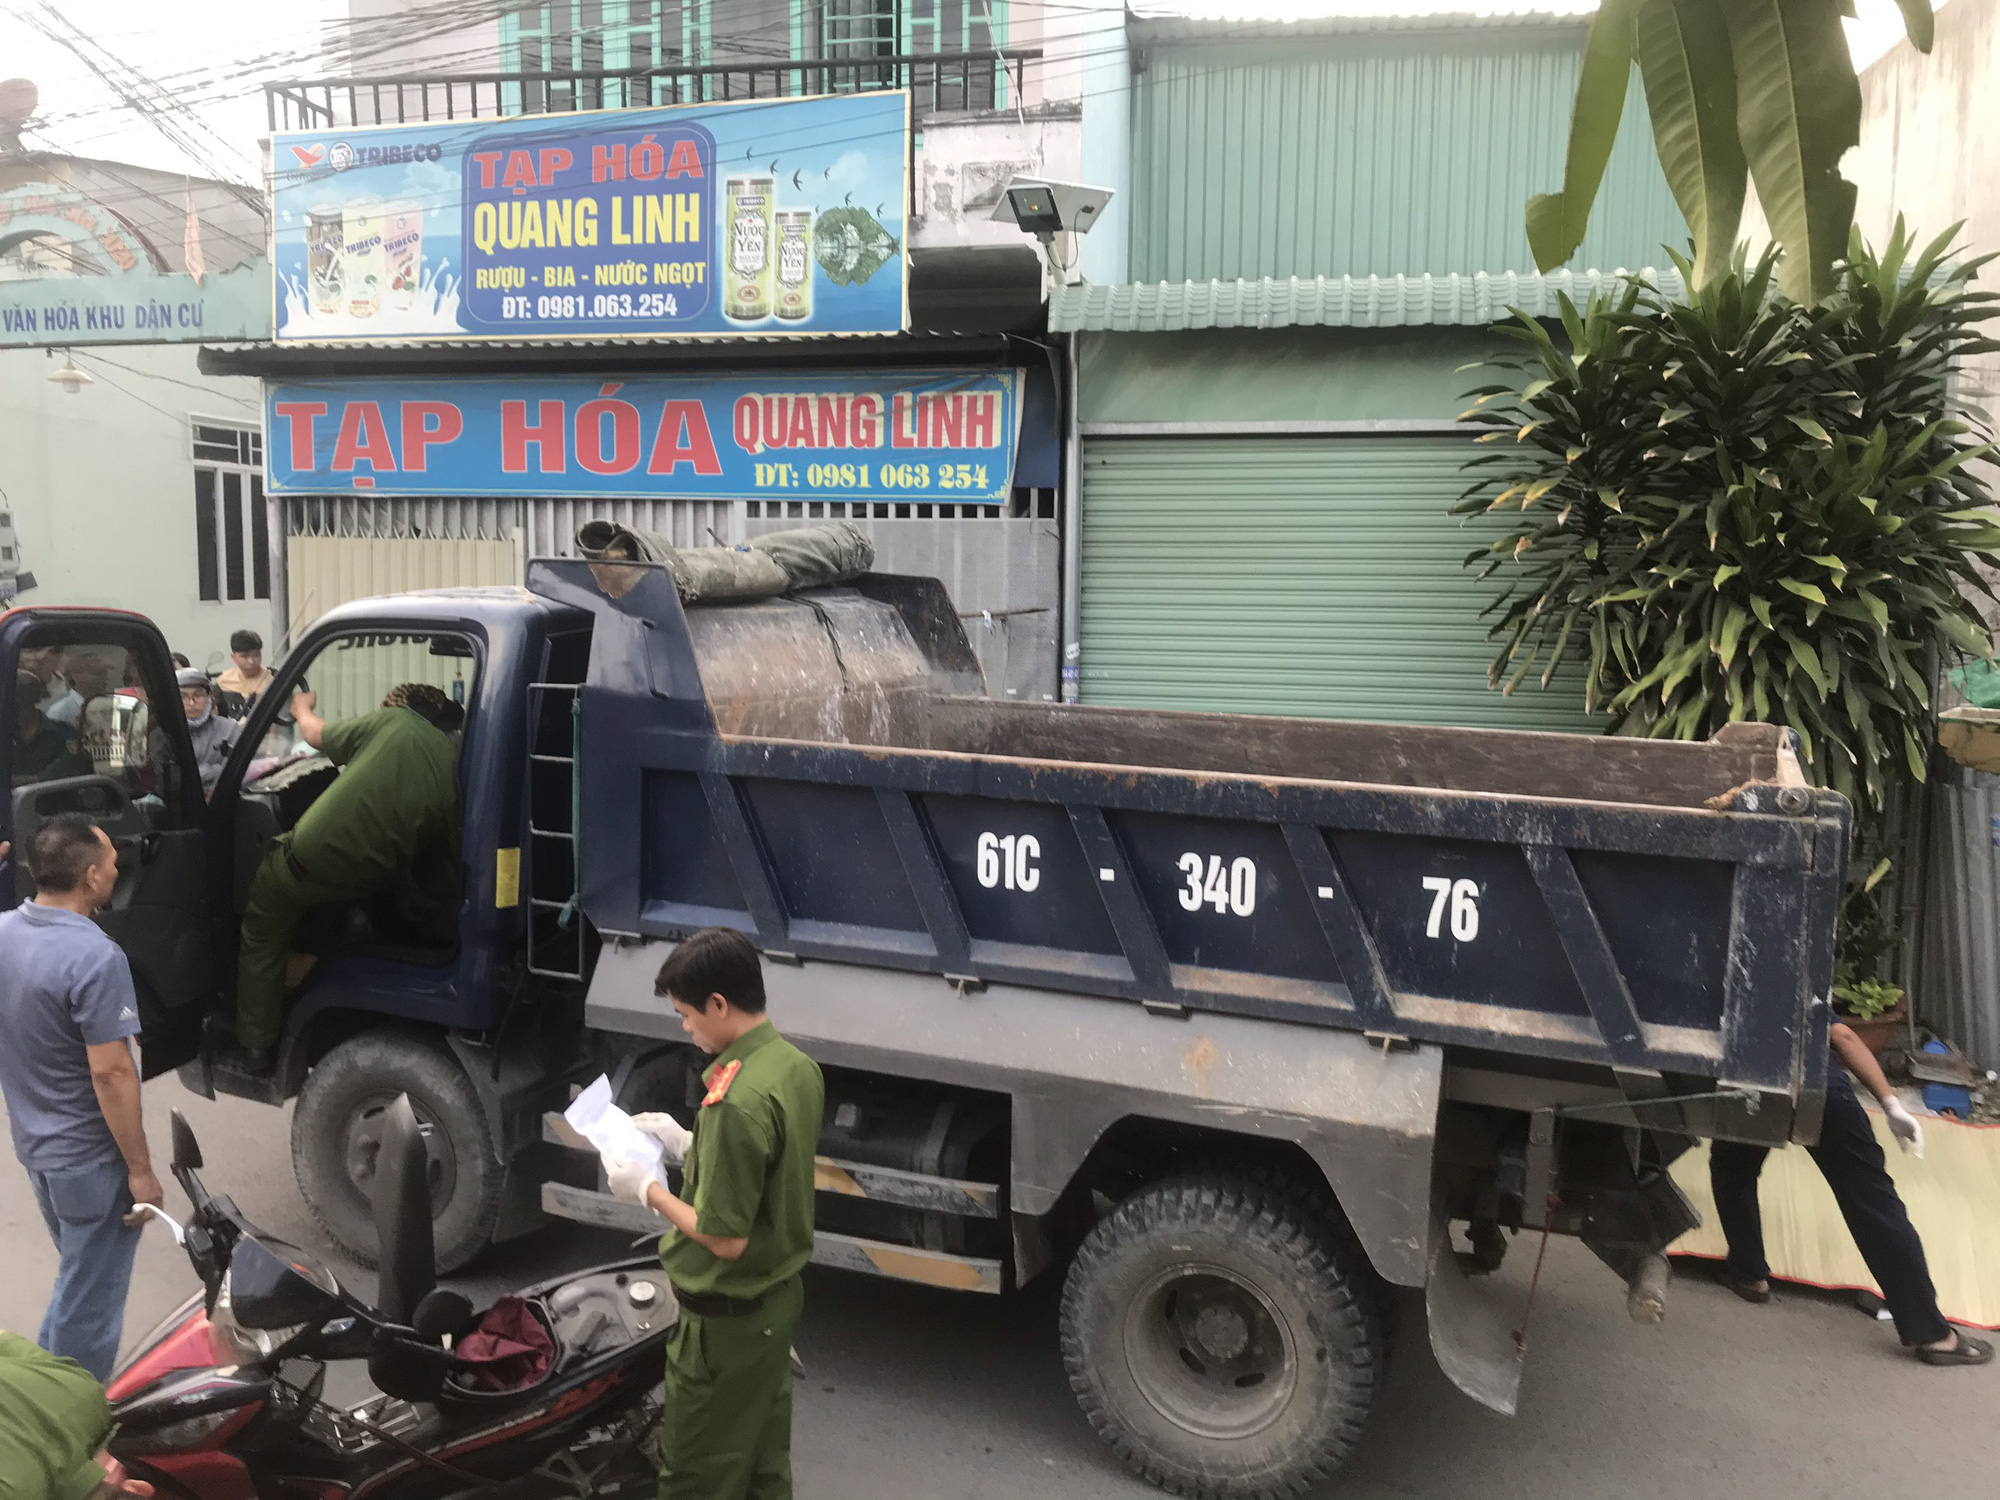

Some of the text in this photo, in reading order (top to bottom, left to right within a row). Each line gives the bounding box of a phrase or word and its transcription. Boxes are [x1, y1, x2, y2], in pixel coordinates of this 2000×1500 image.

[355, 143, 442, 165] TRIBECO
[474, 134, 704, 195] TẠP HÓA
[473, 193, 700, 255] QUANG LINH
[345, 235, 382, 254] TRIBECO
[383, 232, 419, 252] TRIBECO
[476, 265, 526, 292] RƯỢU
[544, 266, 576, 287] BIA
[595, 260, 648, 286] NƯỚC
[653, 262, 706, 289] NGỌT
[3, 301, 37, 332] VĂN
[86, 304, 125, 329] KHU
[135, 299, 172, 328] DÂN
[178, 299, 204, 328] CƯ
[502, 294, 678, 319] ĐT: 0981.063.254
[275, 382, 723, 489] TẠP HÓA
[733, 389, 1002, 455] QUANG LINH
[807, 463, 872, 488] 0981
[880, 463, 930, 488] 063
[938, 463, 990, 489] 254
[976, 831, 1041, 892] 61C
[1176, 851, 1257, 918] 340
[1422, 875, 1480, 942] 76
